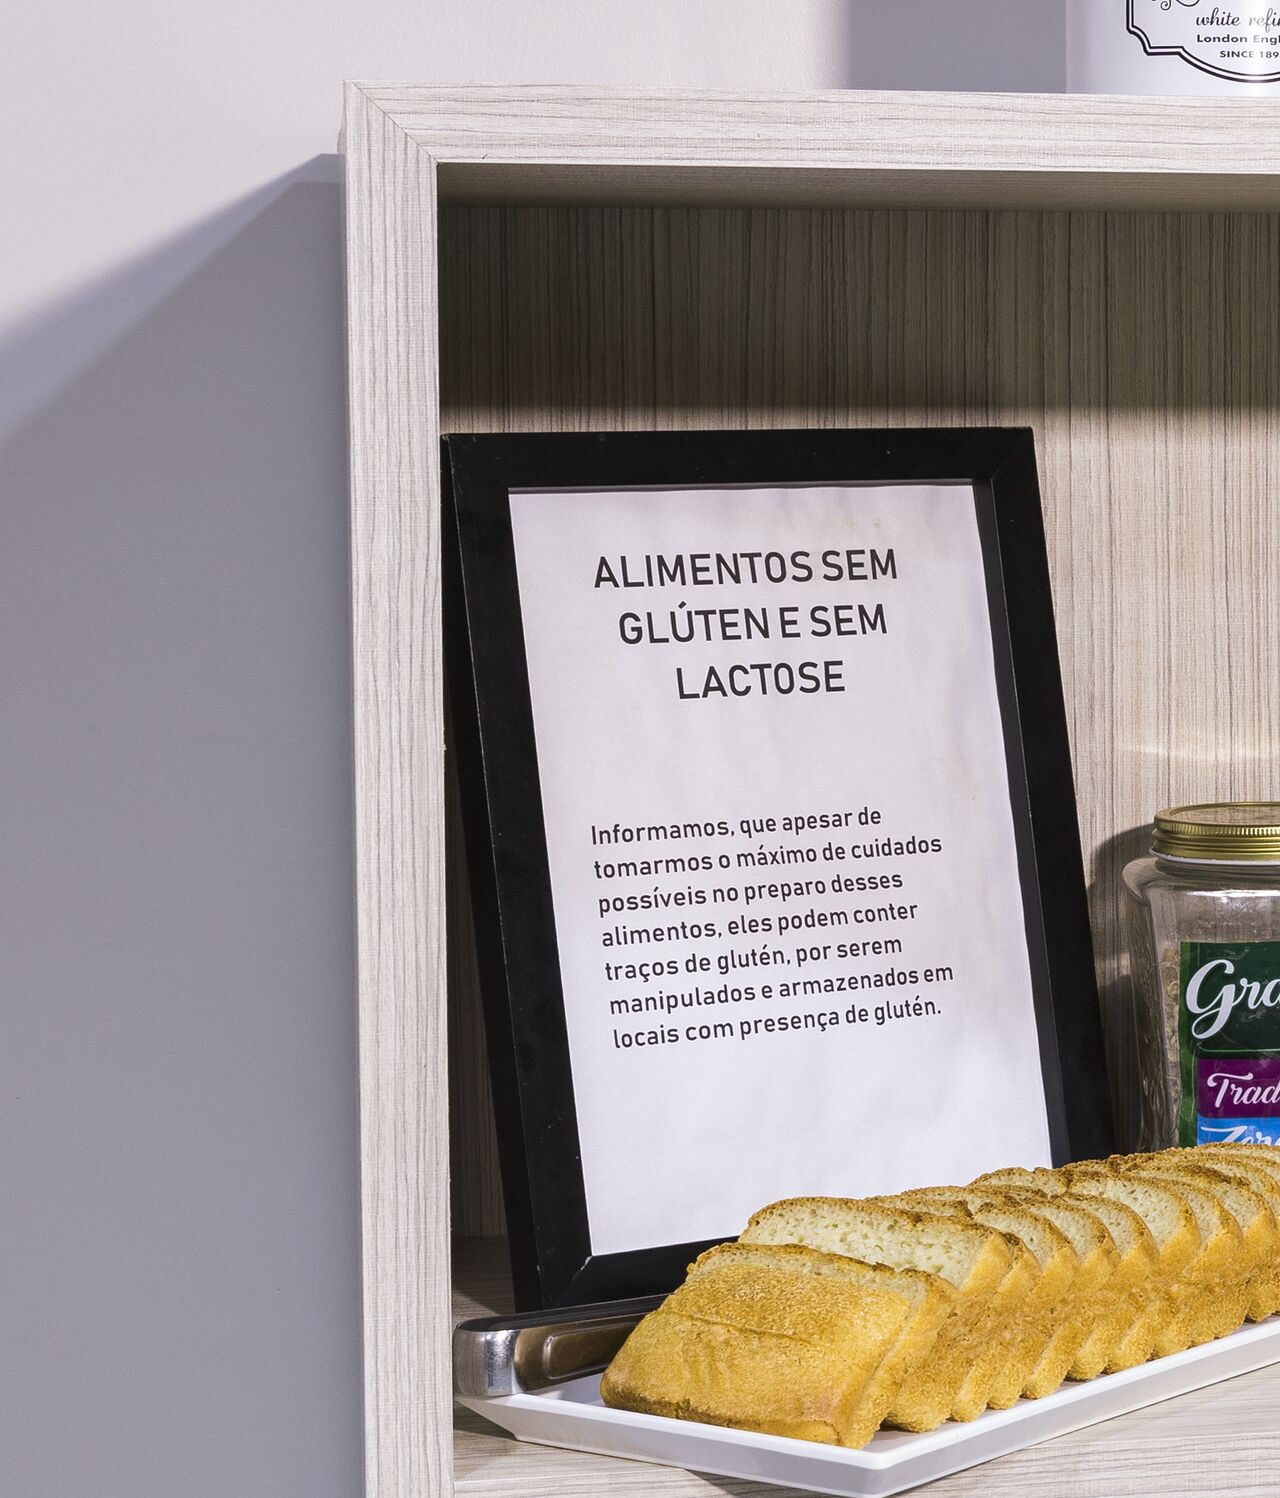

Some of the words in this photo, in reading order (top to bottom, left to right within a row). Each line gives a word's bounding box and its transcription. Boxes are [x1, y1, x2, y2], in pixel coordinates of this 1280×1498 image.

[1195, 7, 1240, 27] white
[1197, 34, 1248, 44] London
[1219, 50, 1255, 59] SINCE
[594, 551, 814, 589] ALIMENTOS
[822, 548, 898, 581] SEM
[618, 601, 770, 645] GLÚTEN
[779, 607, 801, 638] E
[810, 604, 888, 638] SEM
[676, 660, 846, 700] LACTOSE
[591, 820, 735, 846] Informamos,
[740, 816, 777, 839] que
[782, 809, 853, 836] apesar
[858, 806, 882, 826] de
[594, 851, 714, 879] tomarmos
[719, 853, 731, 869] o
[736, 845, 818, 868] máximo
[823, 841, 846, 861] de
[851, 835, 943, 859] cuidados
[598, 885, 707, 918] possíveis
[713, 887, 739, 904] no
[744, 879, 826, 906] preparo
[831, 871, 903, 893] desses
[602, 921, 723, 947] alimentos,
[727, 914, 773, 936] eles
[778, 906, 849, 936] podem
[853, 901, 919, 924] conter
[605, 960, 678, 983] traços
[685, 953, 711, 974] de
[717, 945, 792, 975] glutén,
[796, 944, 832, 968] por
[836, 937, 903, 959] serem
[609, 985, 756, 1015] manipulados
[761, 985, 773, 1000] e
[779, 966, 919, 998] armazenados
[923, 964, 954, 983] em
[613, 1028, 680, 1049] locais
[685, 1021, 734, 1041] com
[740, 1009, 840, 1041] presença
[845, 1005, 869, 1025] de
[874, 994, 942, 1026] glutén.
